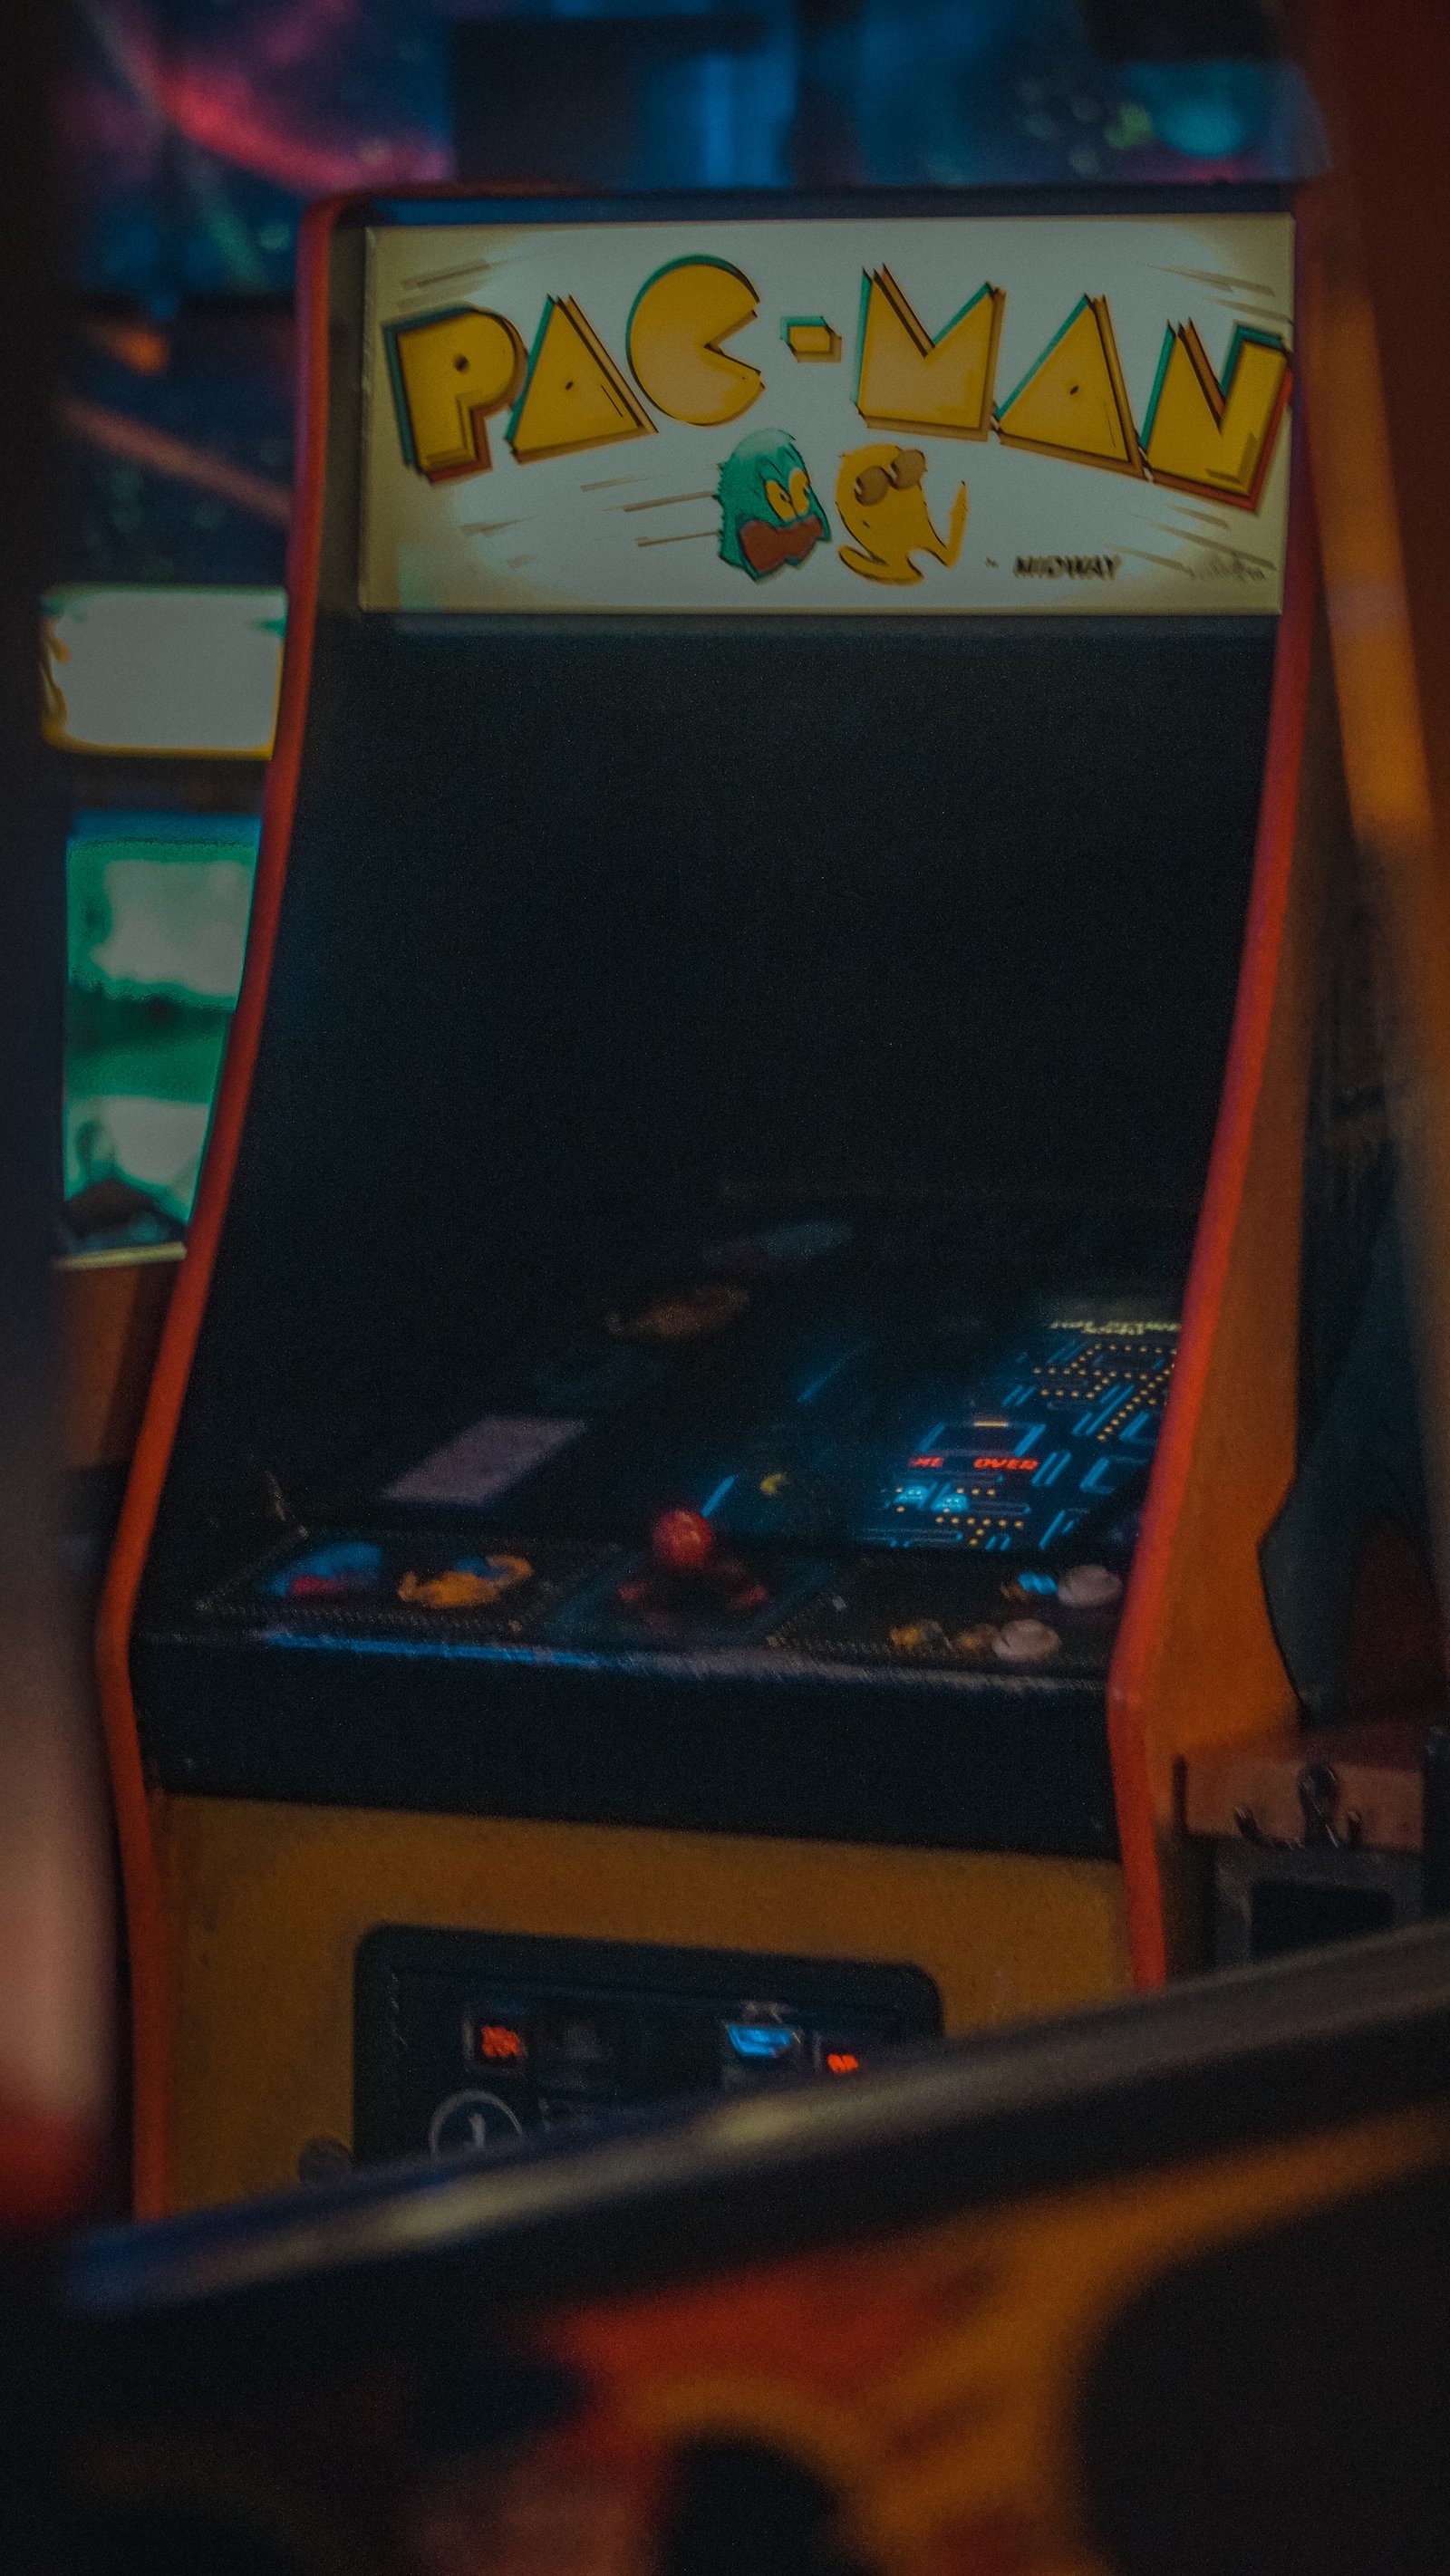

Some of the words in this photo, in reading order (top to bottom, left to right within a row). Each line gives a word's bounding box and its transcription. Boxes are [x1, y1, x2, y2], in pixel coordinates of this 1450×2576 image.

[381, 255, 1293, 515] PAC-MAN
[1013, 555, 1122, 580] MIDWAY
[972, 1457, 1039, 1471] OVER
